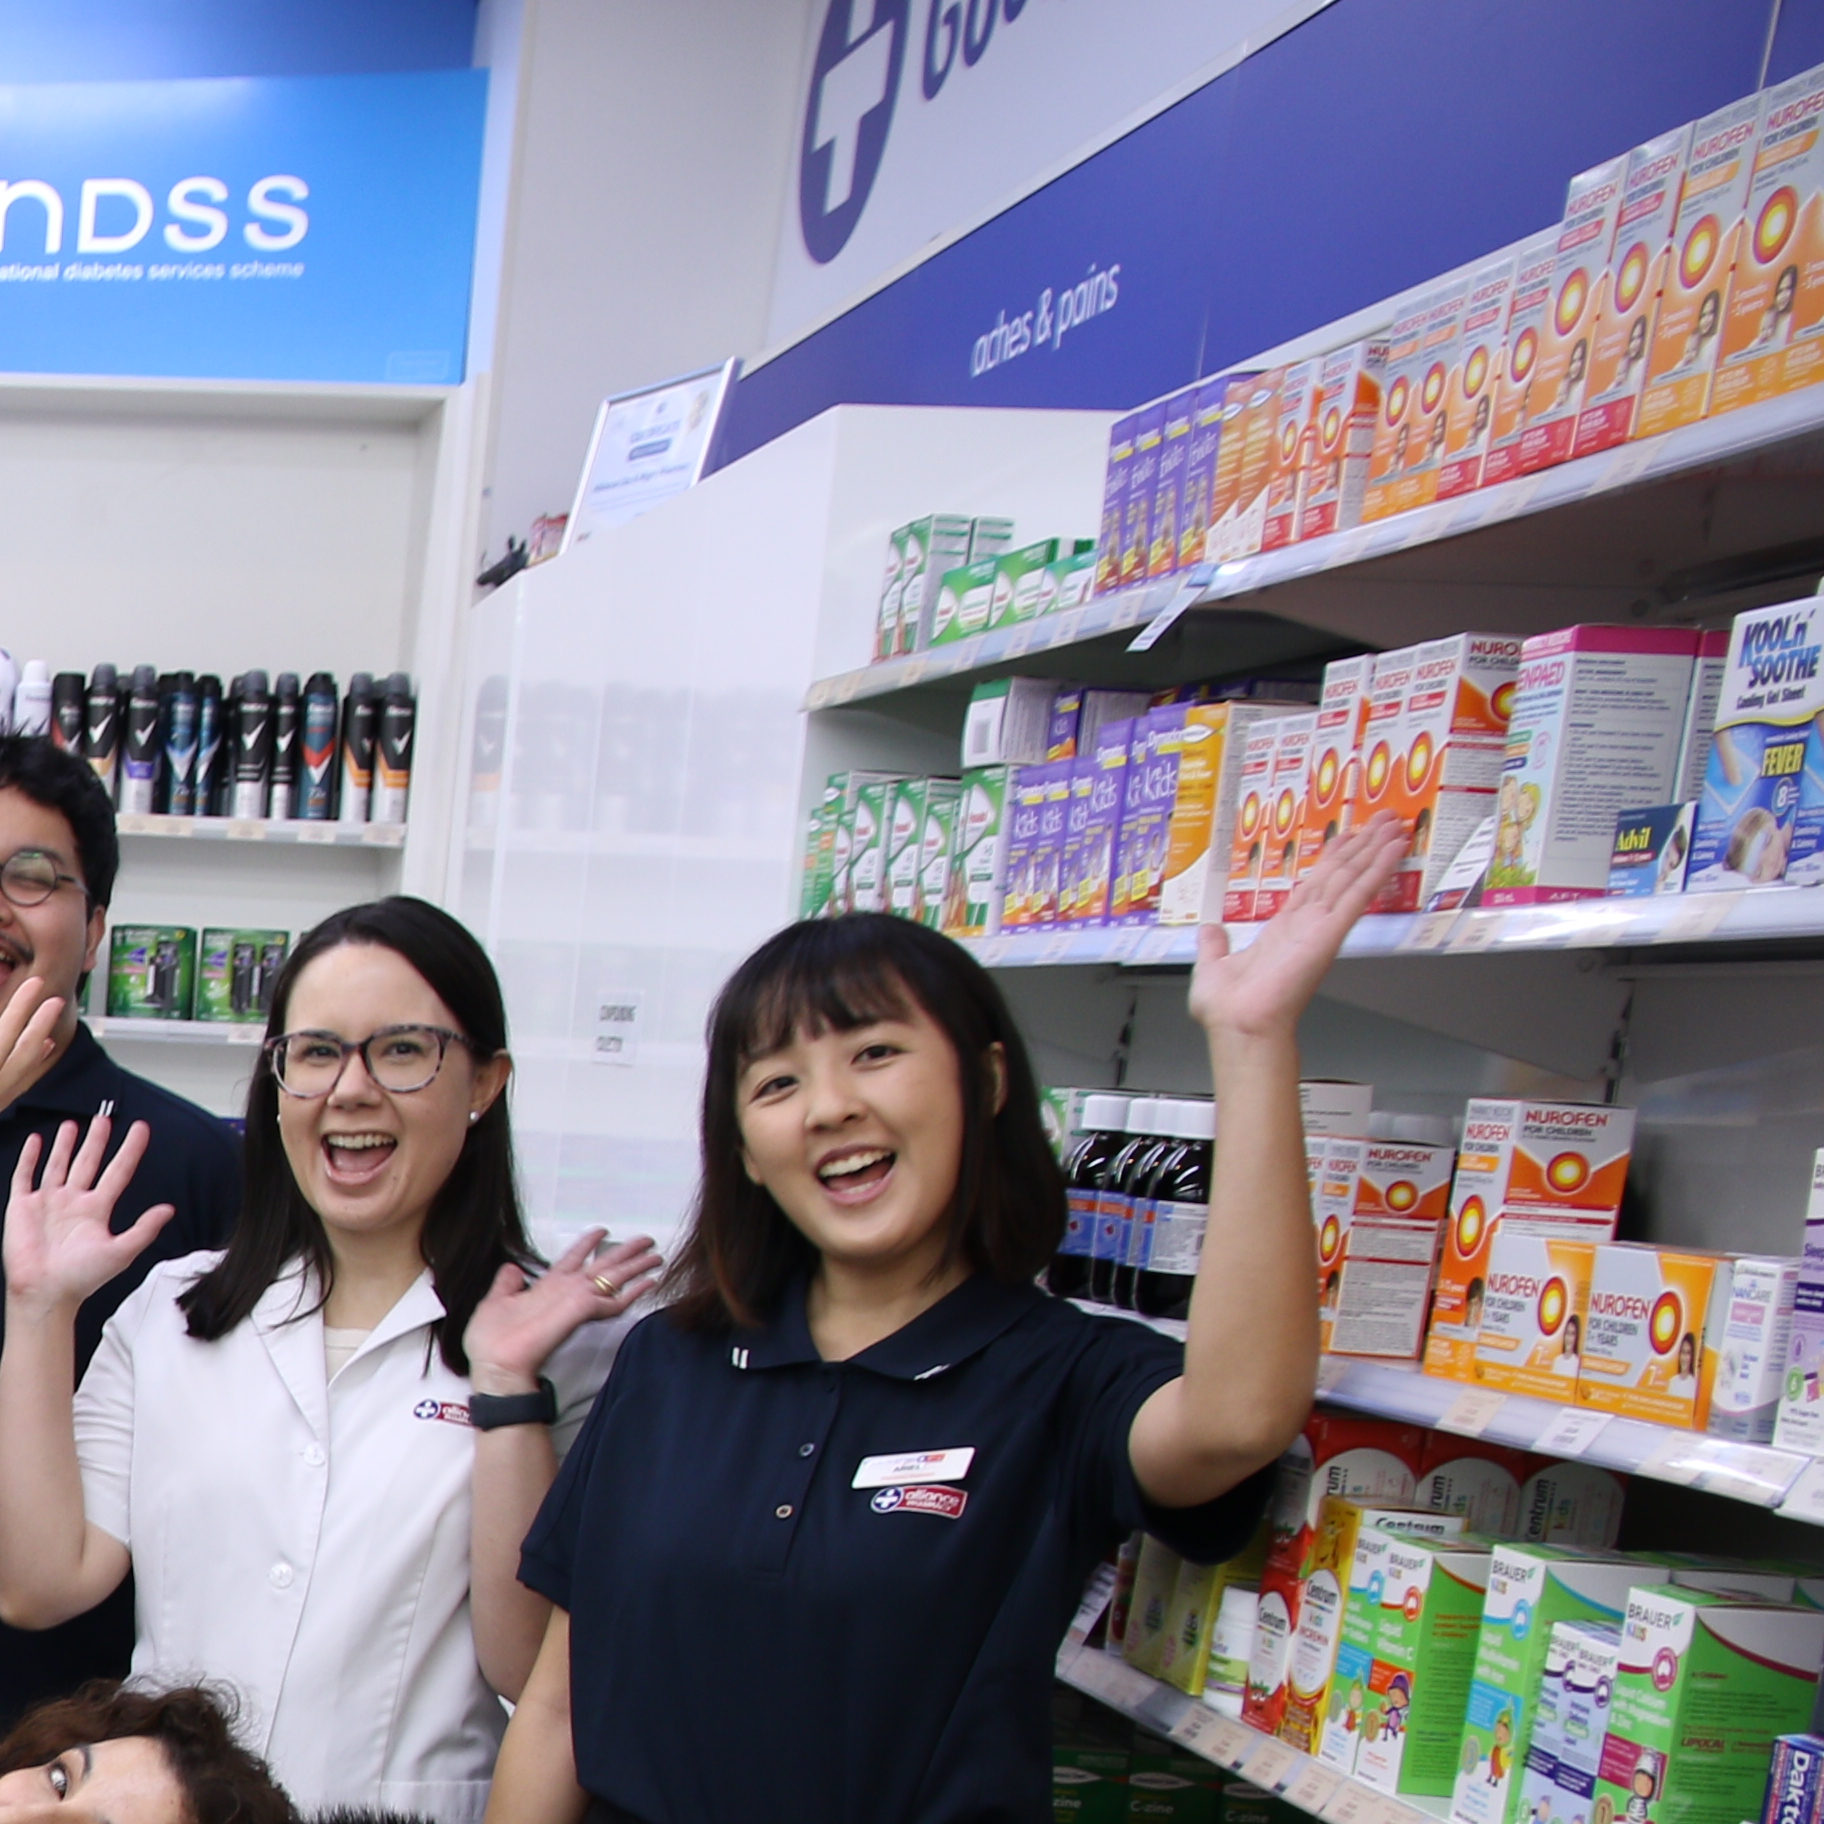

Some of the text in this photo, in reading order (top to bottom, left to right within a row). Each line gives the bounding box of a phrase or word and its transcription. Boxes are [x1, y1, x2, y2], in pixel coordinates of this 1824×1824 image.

[1693, 120, 1755, 160] NUROFEN
[1629, 153, 1678, 188] NUROFEN
[1567, 183, 1618, 215] NUROFEN
[63, 261, 144, 282] diabetes
[148, 261, 225, 282] services
[228, 261, 305, 281] scheme
[971, 263, 1121, 378] aches & pains
[1416, 656, 1459, 681] NUROFEN
[1748, 643, 1823, 689] SOOTHE
[1325, 676, 1359, 698] NUROFEN
[1375, 668, 1412, 691] NUROFEN
[1781, 684, 1807, 701] Sheet
[1761, 742, 1806, 777] FEVER
[1145, 760, 1178, 800] Kids
[1615, 827, 1652, 852] Advil
[1525, 1109, 1608, 1127] NUROFEN
[1467, 1123, 1512, 1142] NUROFEN
[1523, 1125, 1593, 1136] FOR CHILDREN
[1367, 1149, 1434, 1162] NUROFEN
[1383, 1161, 1420, 1170] CHILDREN
[1487, 1272, 1541, 1299] NUROFEN
[1733, 1286, 1772, 1304] NANCARE
[1498, 1297, 1526, 1313] CHILDREN
[1590, 1291, 1651, 1320] NUROFEN
[1493, 1309, 1511, 1325] YEARS
[1588, 1316, 1639, 1336] FOR CHILDREN
[1596, 1332, 1618, 1348] YEARS
[906, 1487, 960, 1508] alliance
[1389, 1551, 1420, 1571] BRAUER
[1492, 1559, 1528, 1585] BRAUER
[1307, 1577, 1338, 1606] Centrum
[1258, 1605, 1287, 1632] Centrum
[1627, 1602, 1673, 1631] BRAUER
[1625, 1620, 1648, 1643] KIDS
[1579, 1648, 1609, 1669] BRAUER
[1129, 1799, 1175, 1815] C-zine
[1224, 1809, 1270, 1824] C-zine
